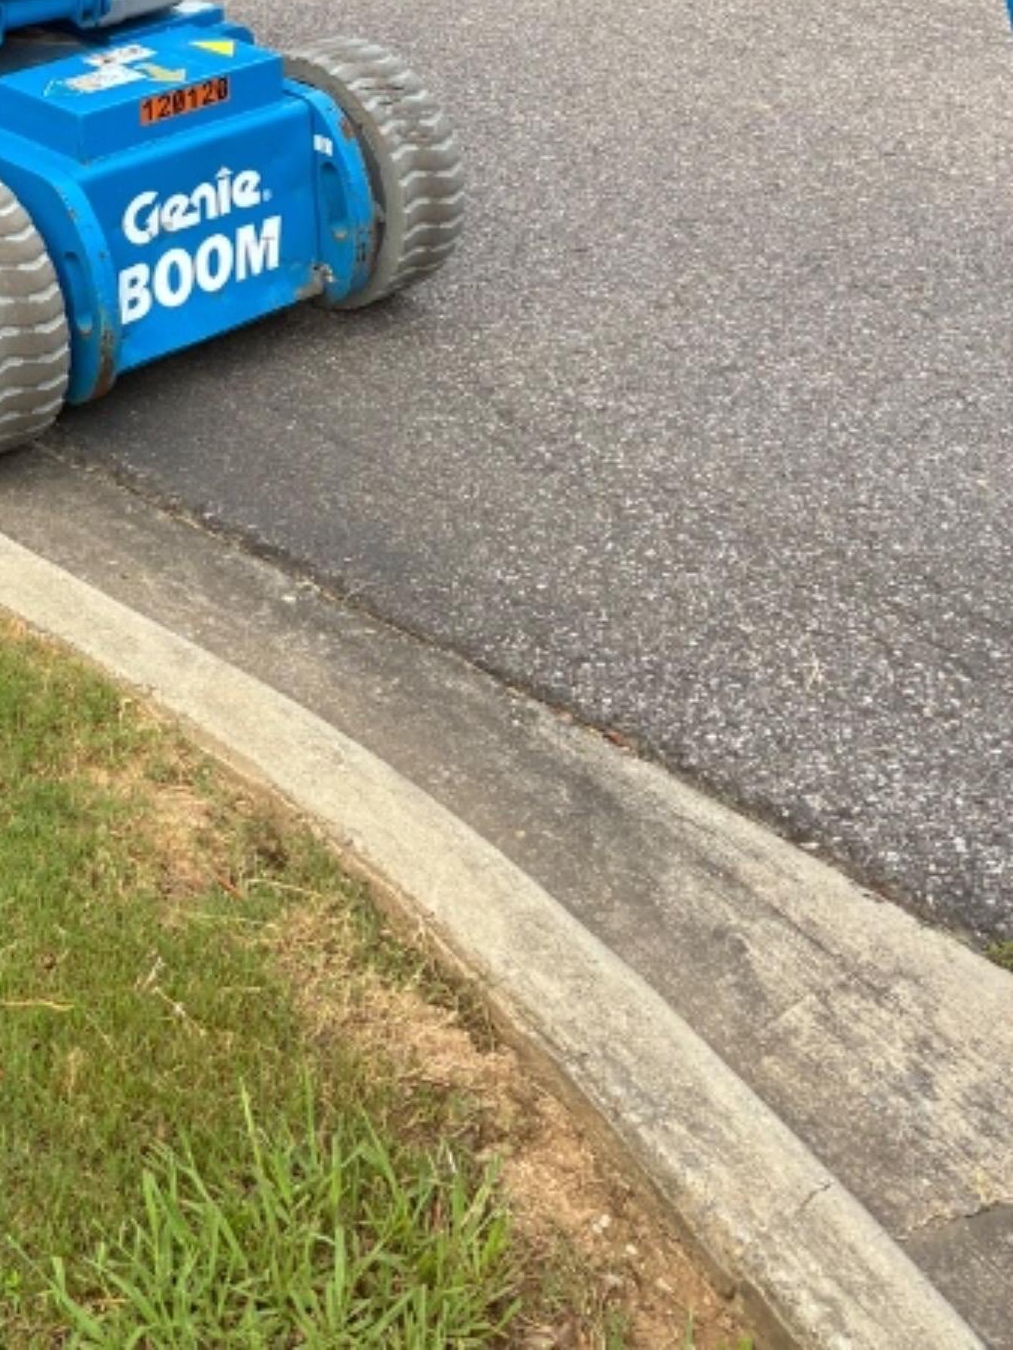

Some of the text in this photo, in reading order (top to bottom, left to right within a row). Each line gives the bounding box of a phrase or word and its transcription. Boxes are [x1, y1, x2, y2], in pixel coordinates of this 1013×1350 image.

[142, 77, 229, 123] 120120
[122, 166, 263, 245] Genie
[118, 215, 282, 325] BOOM
